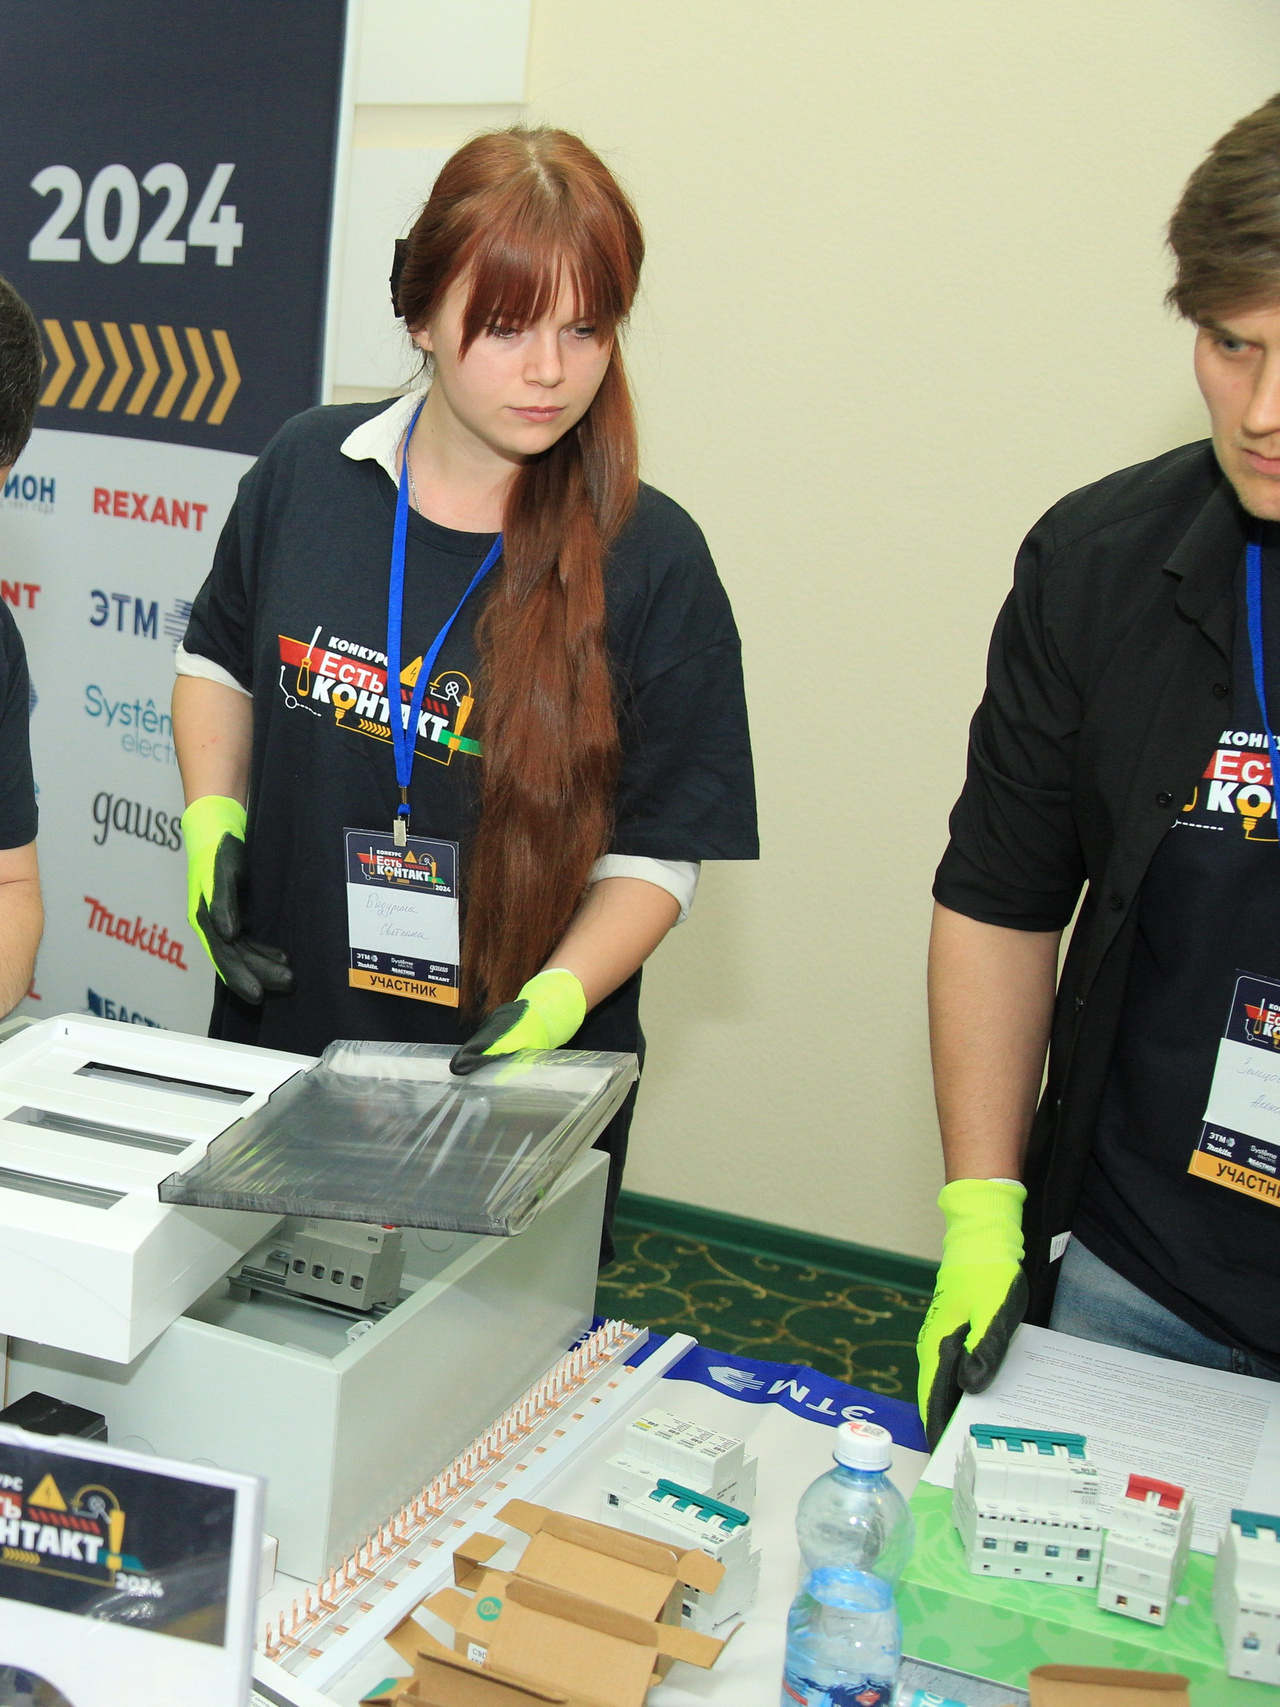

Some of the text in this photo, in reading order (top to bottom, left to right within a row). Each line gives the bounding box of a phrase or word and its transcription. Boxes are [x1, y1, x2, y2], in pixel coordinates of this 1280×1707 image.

[28, 162, 244, 266] 2024
[93, 487, 208, 532] REXANT
[90, 589, 159, 640] ЭТМ
[93, 792, 182, 851] gauss
[376, 849, 402, 858] КОНКУРС
[376, 867, 431, 882] КОНТАКТ
[435, 884, 452, 893] 2024
[369, 974, 437, 998] УЧАСТНИК
[1208, 1131, 1227, 1144] ЭТМ
[767, 1379, 876, 1422] ЭТМ
[114, 1570, 165, 1599] 2024
